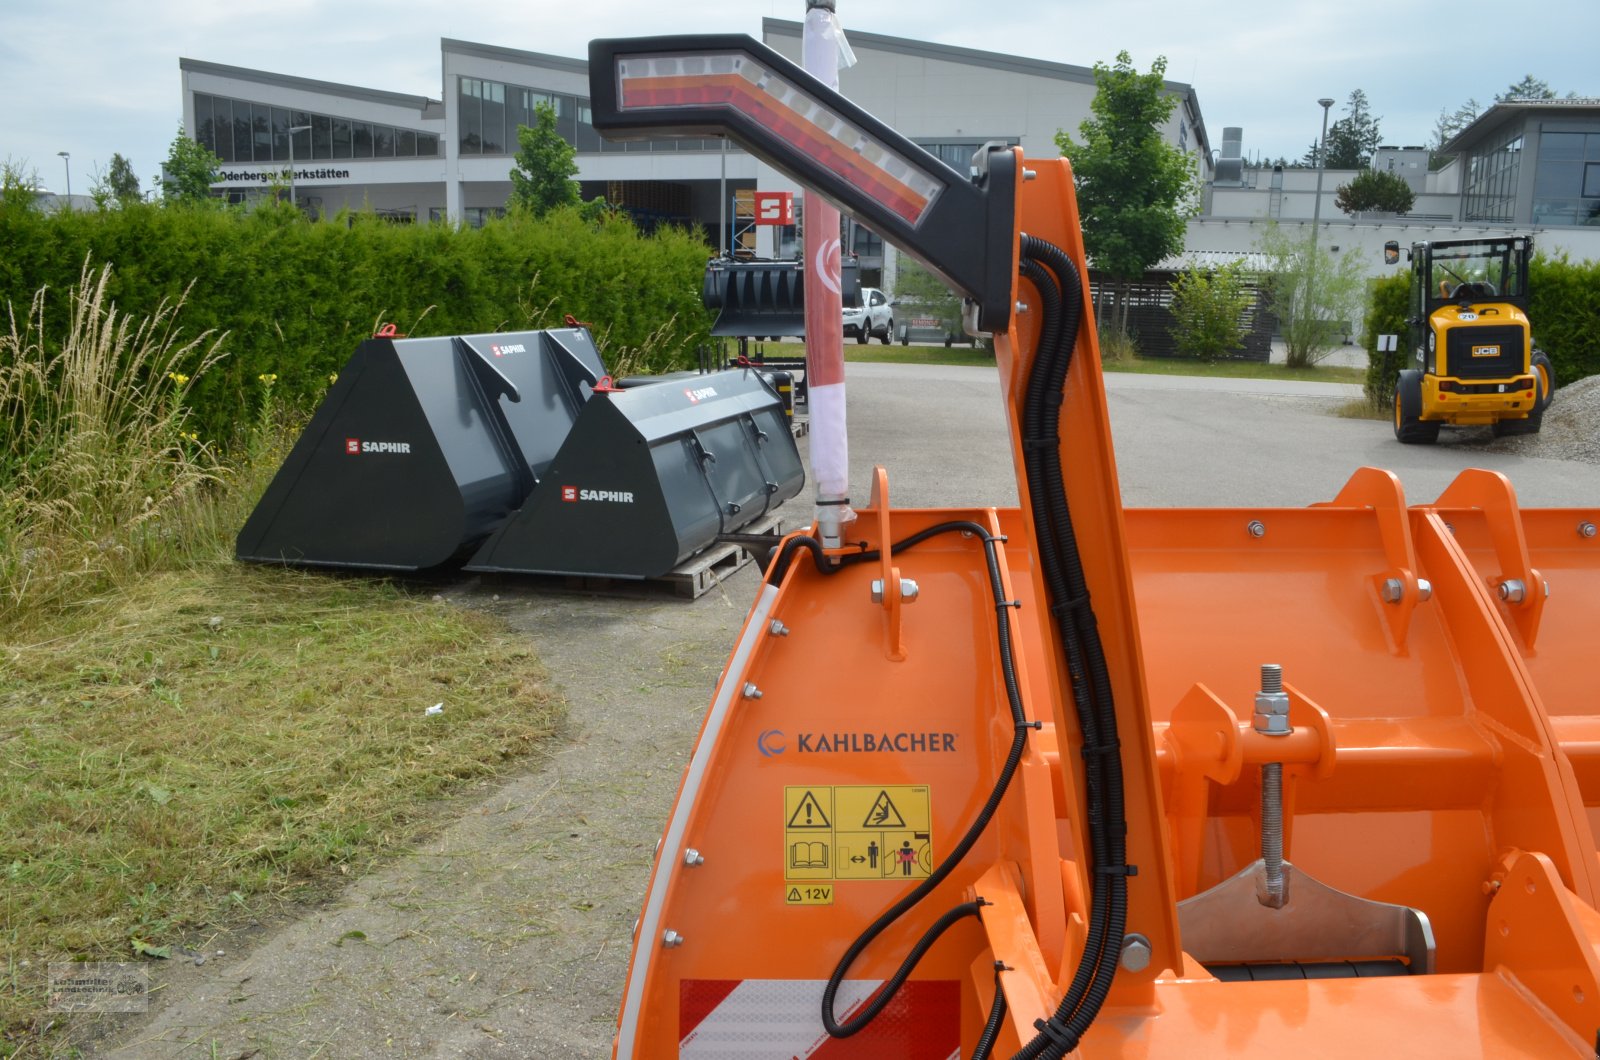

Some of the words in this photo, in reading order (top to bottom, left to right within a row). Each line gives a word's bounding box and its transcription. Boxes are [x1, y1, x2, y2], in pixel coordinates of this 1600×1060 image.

[500, 344, 526, 354] SAPHIR
[1475, 347, 1497, 355] JCB
[362, 441, 411, 453] SAPHIR
[580, 489, 633, 503] SAPHIR
[798, 733, 957, 752] KAHLBACHER
[805, 888, 830, 900] 12V
